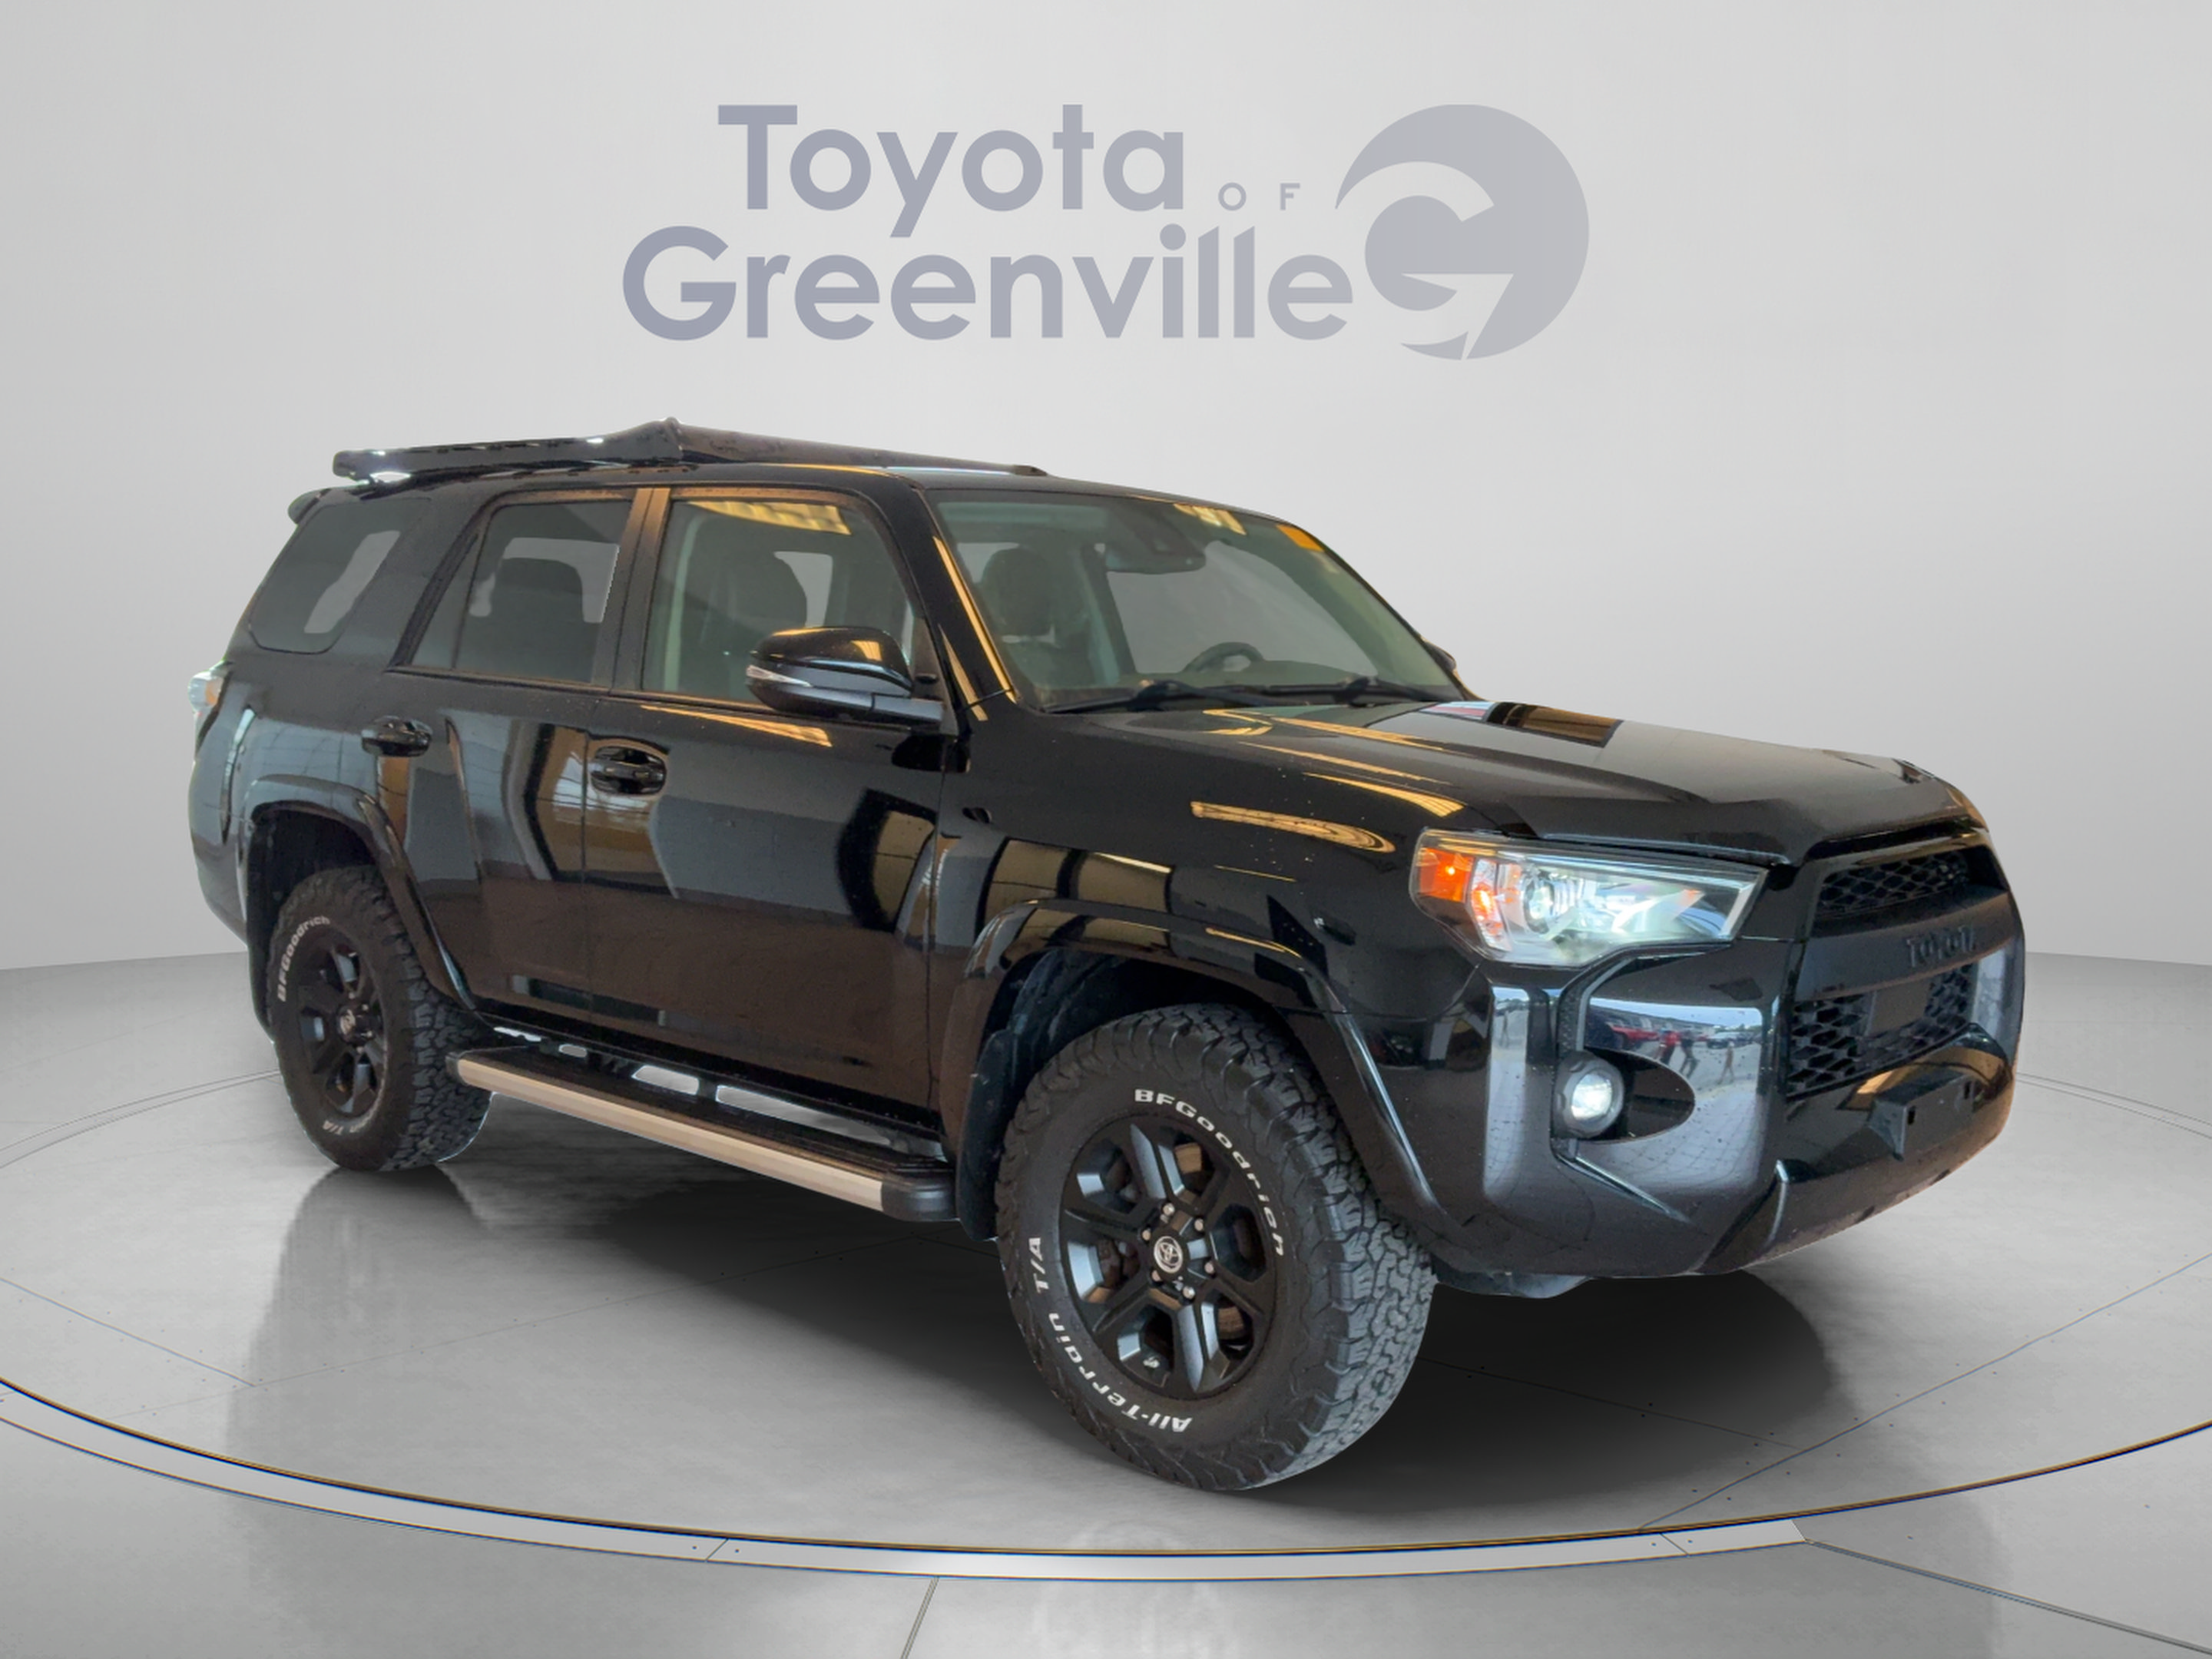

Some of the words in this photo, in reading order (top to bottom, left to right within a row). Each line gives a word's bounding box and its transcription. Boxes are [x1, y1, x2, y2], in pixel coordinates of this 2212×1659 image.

[717, 104, 1184, 238] Toyota
[1217, 182, 1301, 211] OF
[622, 223, 1353, 342] Greenville
[1134, 1089, 1283, 1256] BFGoodrich
[1028, 1237, 1049, 1293] T/A
[1048, 1313, 1193, 1432] All-Terrain
